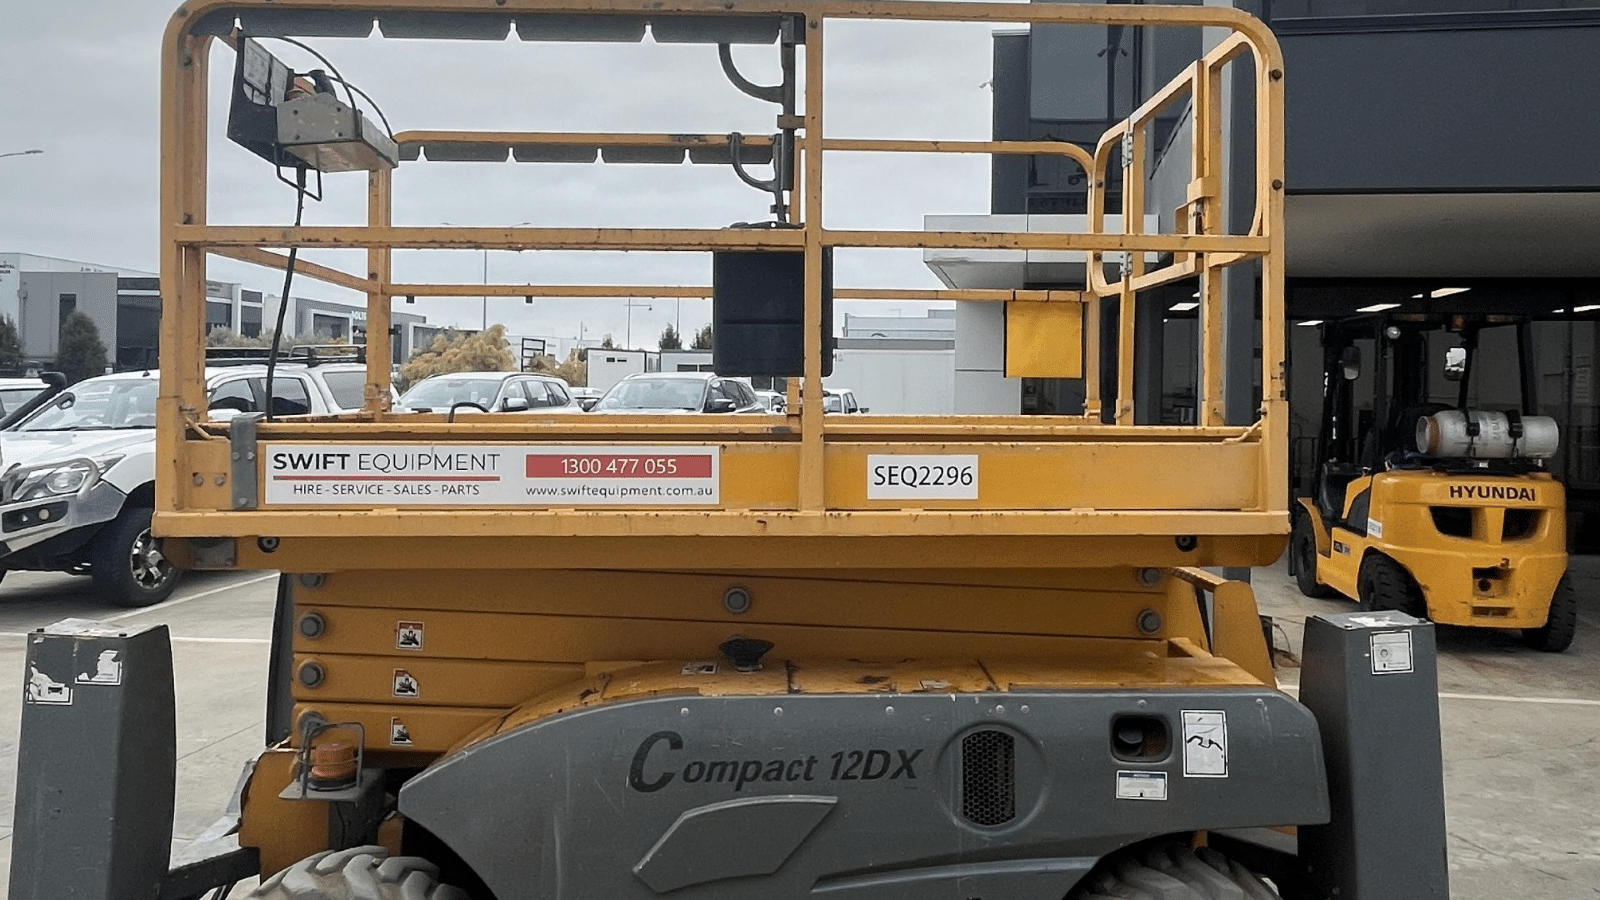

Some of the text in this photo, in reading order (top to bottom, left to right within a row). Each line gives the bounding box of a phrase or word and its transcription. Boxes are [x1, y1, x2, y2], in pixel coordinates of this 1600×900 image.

[273, 453, 500, 473] SWIFT EQUIPMENT
[561, 458, 677, 474] 1300 477 055
[874, 465, 973, 488] SEQ2296
[293, 484, 322, 495] HIRE
[332, 484, 384, 495] SERVICE
[394, 484, 431, 495] SALES
[441, 484, 480, 495] PARTS
[526, 484, 713, 498] www.swiftequipment.com.au
[1449, 485, 1536, 501] HYUNDAI
[629, 730, 924, 793] Compact 12DX
